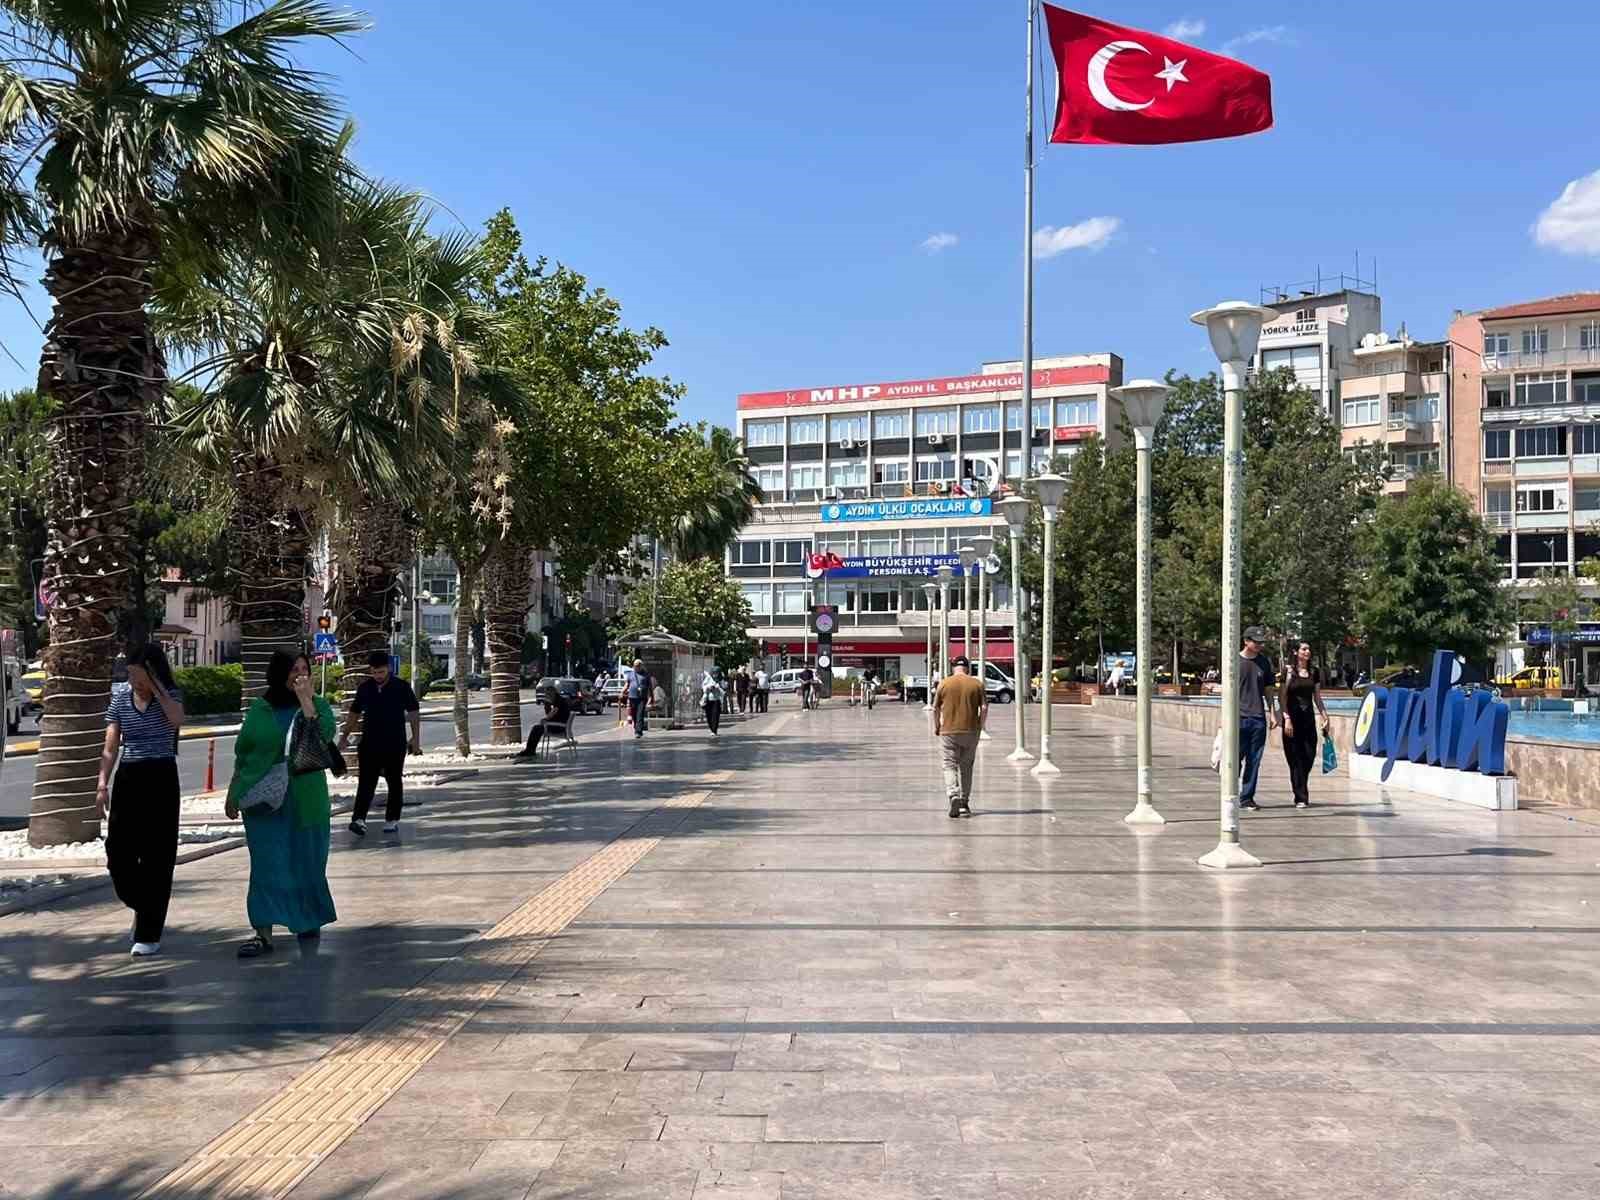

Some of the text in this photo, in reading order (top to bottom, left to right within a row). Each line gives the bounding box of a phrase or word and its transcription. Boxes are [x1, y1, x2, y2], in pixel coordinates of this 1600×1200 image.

[810, 376, 1022, 401] MHP AYDIN İL BAŞKANLIĞI
[846, 505, 874, 516] AYDIN
[879, 502, 907, 515] ÜLKÜ
[842, 560, 864, 568] AYDIN
[865, 556, 932, 568] BÜYÜKŞEHİR
[869, 567, 912, 576] PERSONEL
